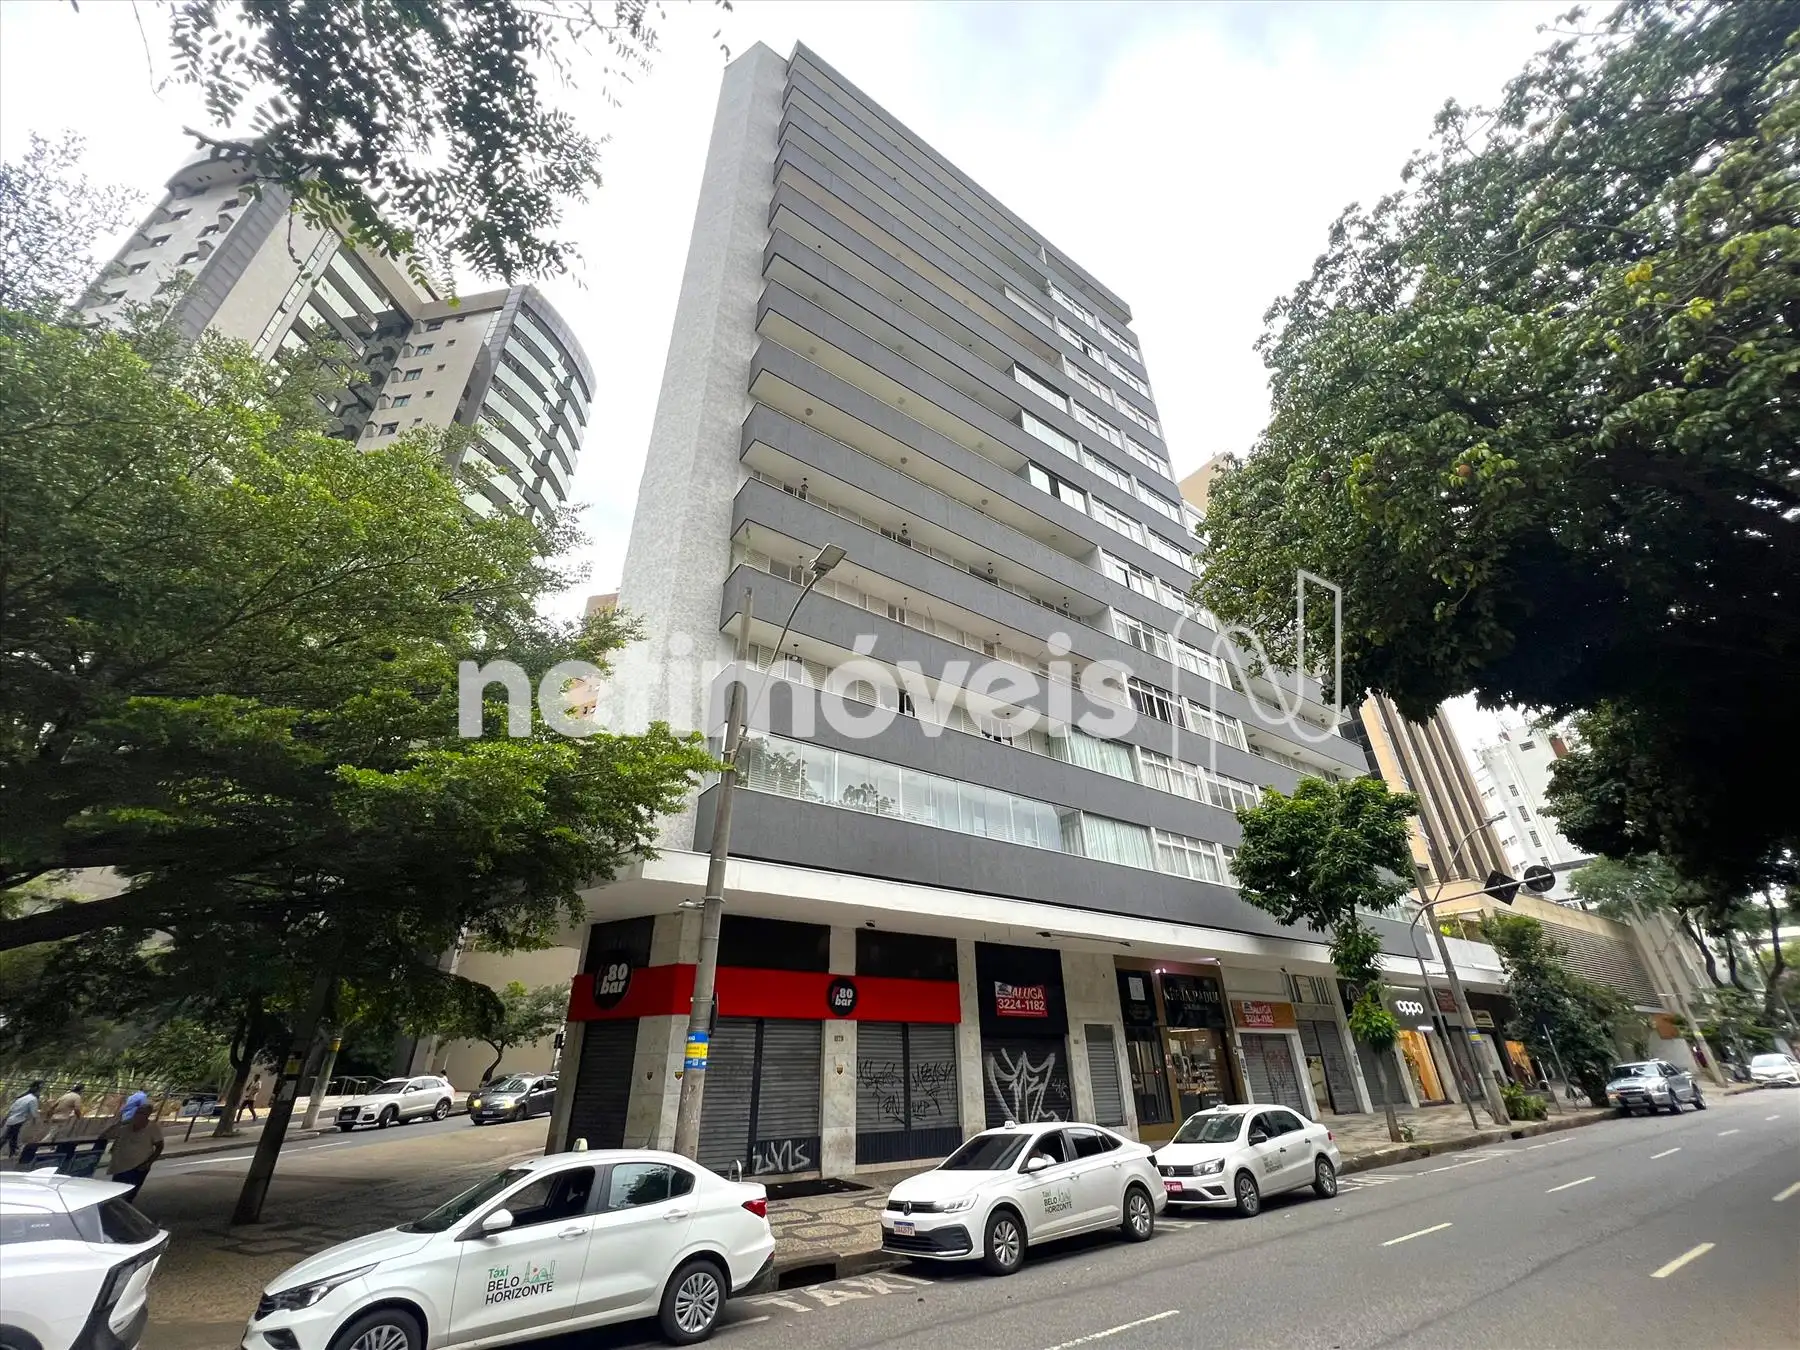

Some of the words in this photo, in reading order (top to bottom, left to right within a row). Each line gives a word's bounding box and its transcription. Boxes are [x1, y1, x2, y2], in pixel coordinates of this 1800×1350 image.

[600, 976, 626, 994] bar
[835, 994, 852, 1006] bar
[1012, 987, 1044, 1000] ALUGA
[998, 999, 1045, 1011] 3224-1182
[1396, 1000, 1424, 1016] oppo
[1043, 1196, 1058, 1206] BELO
[1044, 1201, 1073, 1214] HORIZONTE
[487, 1276, 520, 1292] BELO
[485, 1281, 554, 1305] HORIZONTE
